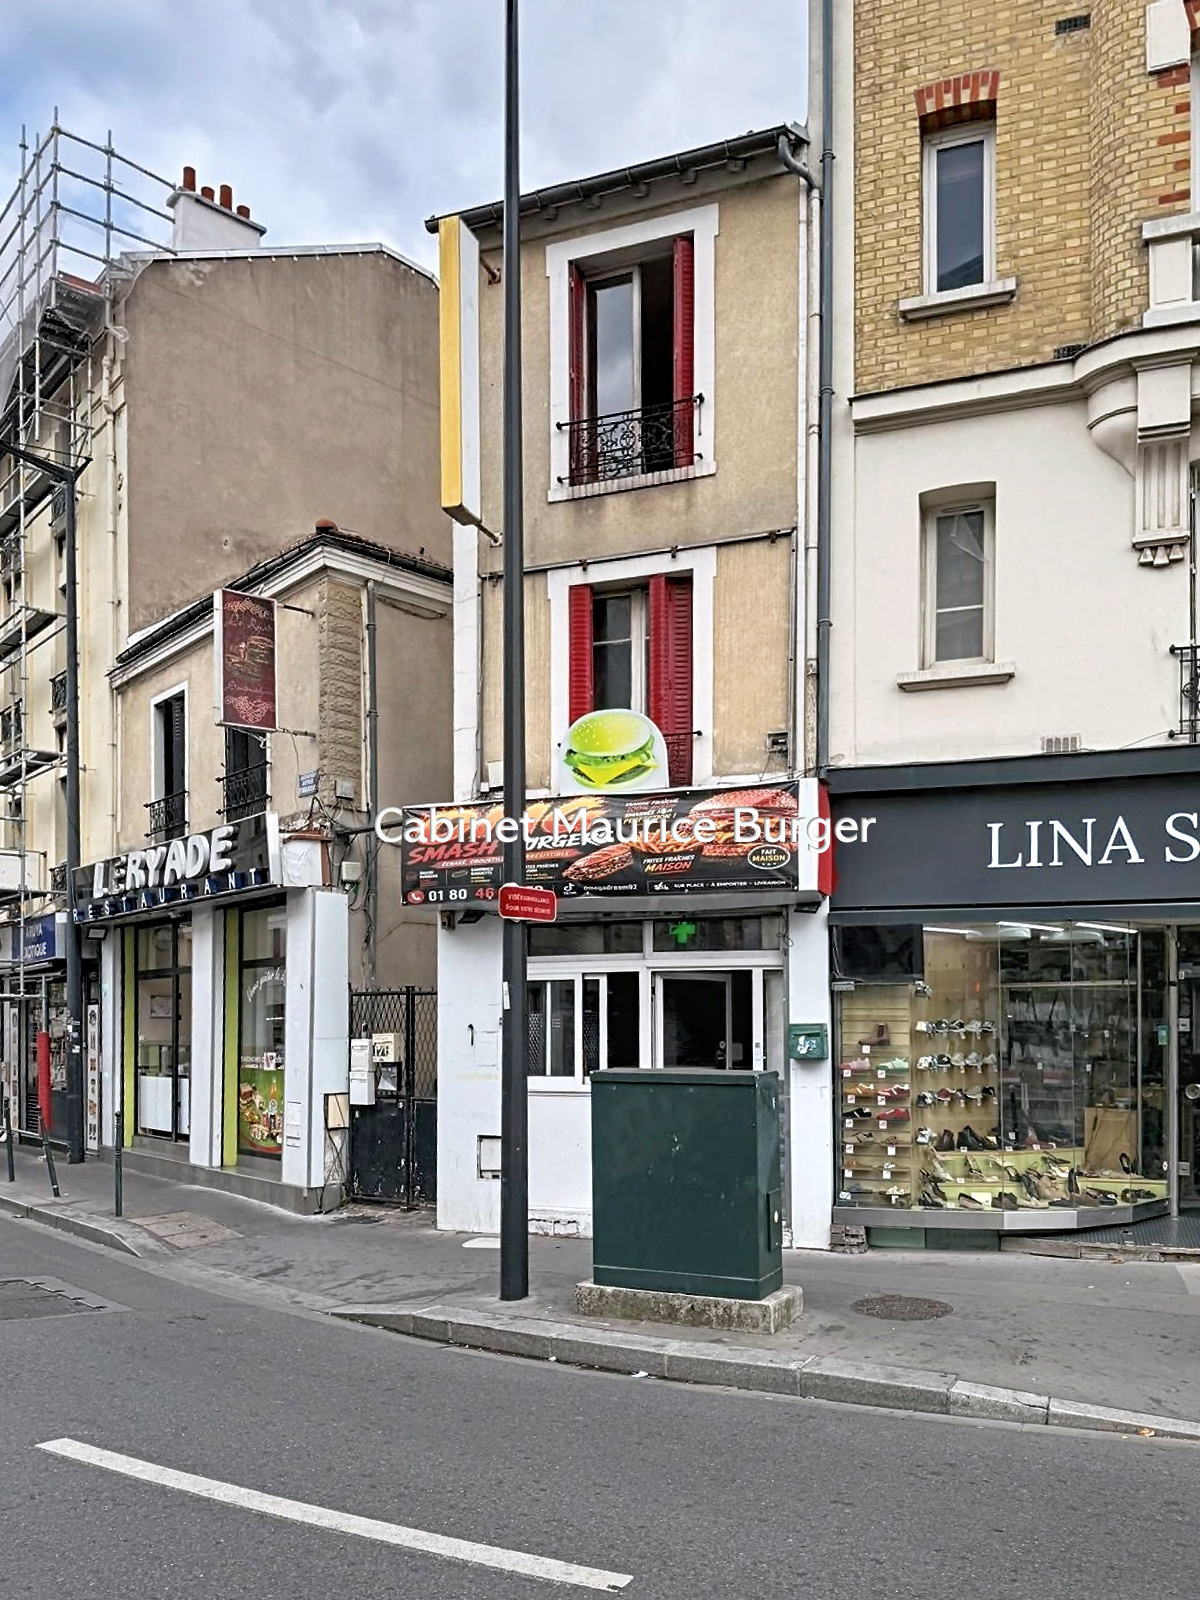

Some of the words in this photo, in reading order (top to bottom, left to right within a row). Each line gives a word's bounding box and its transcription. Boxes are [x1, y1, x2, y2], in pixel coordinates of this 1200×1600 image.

[987, 815, 1145, 868] LINA
[1165, 812, 1200, 862] S
[407, 839, 499, 866] SMASH
[664, 854, 695, 863] FRAÎCHES
[752, 854, 786, 862] MAISON
[644, 862, 692, 873] MAISON
[73, 867, 260, 922] RESTAURANT
[428, 890, 444, 901] 01
[448, 888, 468, 900] 80
[475, 887, 495, 899] 46
